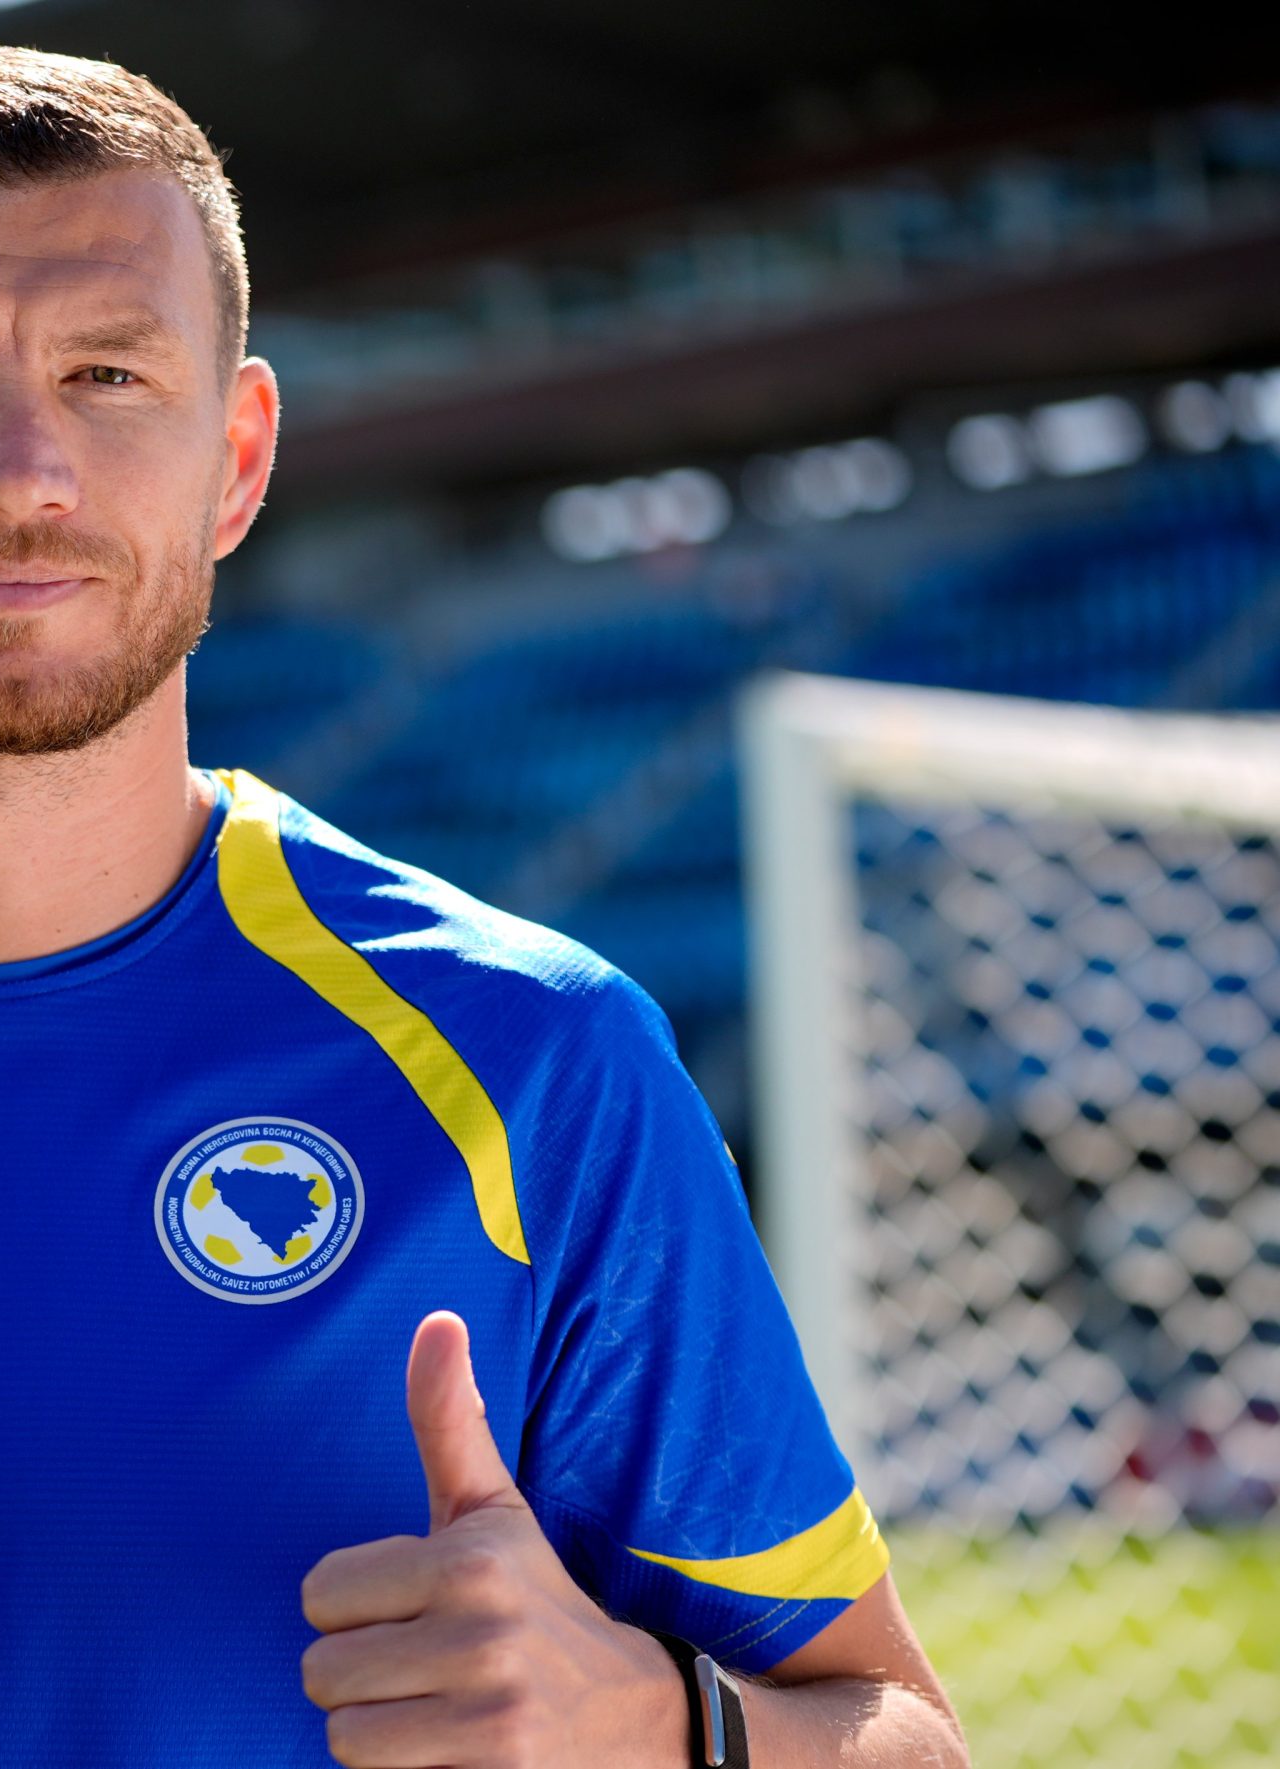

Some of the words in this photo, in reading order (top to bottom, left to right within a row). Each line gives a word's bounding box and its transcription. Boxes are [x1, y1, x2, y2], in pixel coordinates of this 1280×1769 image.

[177, 1155, 201, 1181] BOSNA
[201, 1127, 261, 1155] HERCEGOVINA
[263, 1127, 292, 1138] БОСНА
[293, 1132, 302, 1141] И
[301, 1135, 347, 1180] ХЕРЦЕГОВИНА
[168, 1197, 185, 1244] NOGOMETNI
[181, 1247, 221, 1282] FUDBALSKI
[221, 1276, 251, 1291] SAVEZ
[251, 1270, 306, 1291] НОГОМЕТНИ
[310, 1223, 348, 1270] ФУДБАЛСКИ
[340, 1197, 352, 1224] САВЕЗ
